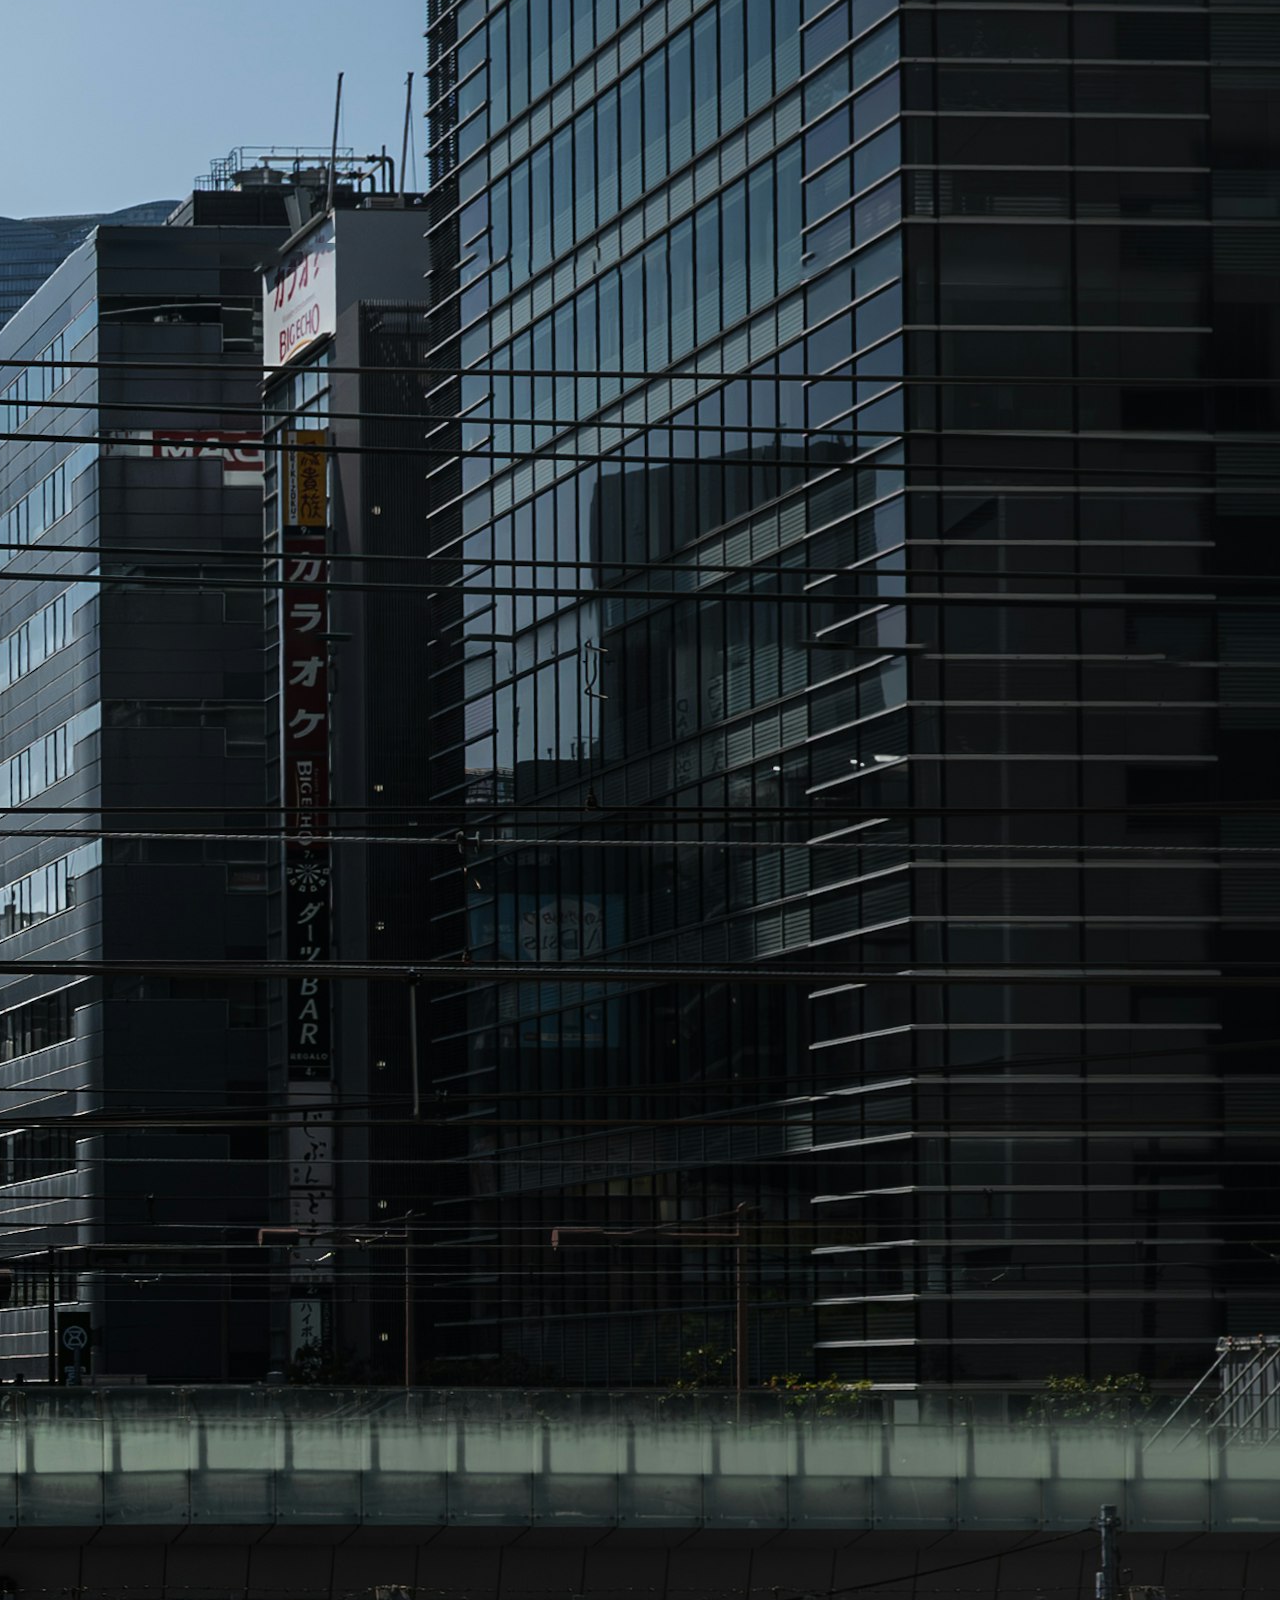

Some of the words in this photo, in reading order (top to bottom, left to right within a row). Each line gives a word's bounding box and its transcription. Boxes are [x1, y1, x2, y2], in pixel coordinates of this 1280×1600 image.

[279, 323, 297, 363] BIG
[296, 303, 321, 341] ECHO
[289, 552, 327, 740] カラオケ
[296, 760, 313, 794] BIG
[298, 797, 314, 847] EHO
